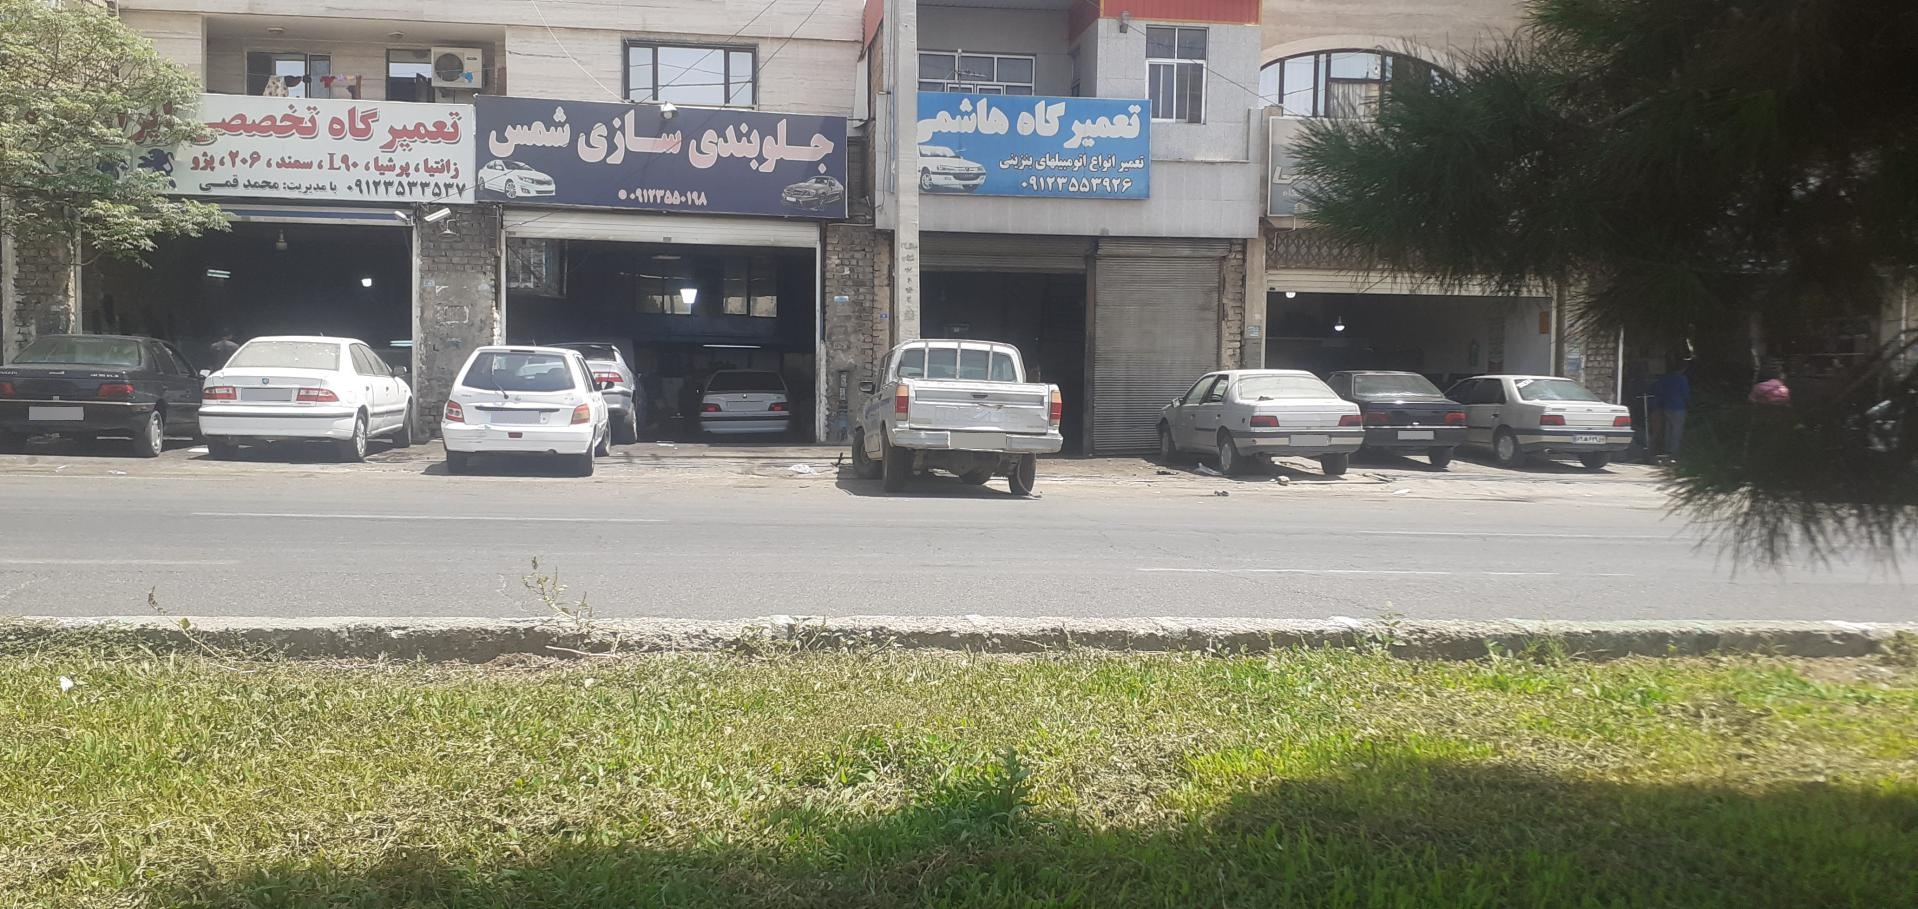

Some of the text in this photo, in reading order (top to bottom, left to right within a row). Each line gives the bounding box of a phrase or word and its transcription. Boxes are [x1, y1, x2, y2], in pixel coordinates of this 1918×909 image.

[488, 106, 835, 173] جلوبندی سازی شمس
[190, 150, 215, 172] پژو
[999, 153, 1144, 173] تعمیر انواع اتومبیلهای بنزینی
[199, 176, 239, 192] قمی
[243, 178, 279, 190] محمد
[328, 181, 338, 192] با
[346, 178, 466, 198] ۰۹۱۲۳۵۳۳۵۳۷
[1020, 175, 1132, 193] ۰۹۱۲۳۵۵۳۹۲۶
[629, 187, 708, 206] ۰۹۱۲۳۵۵۰۱۹۸
